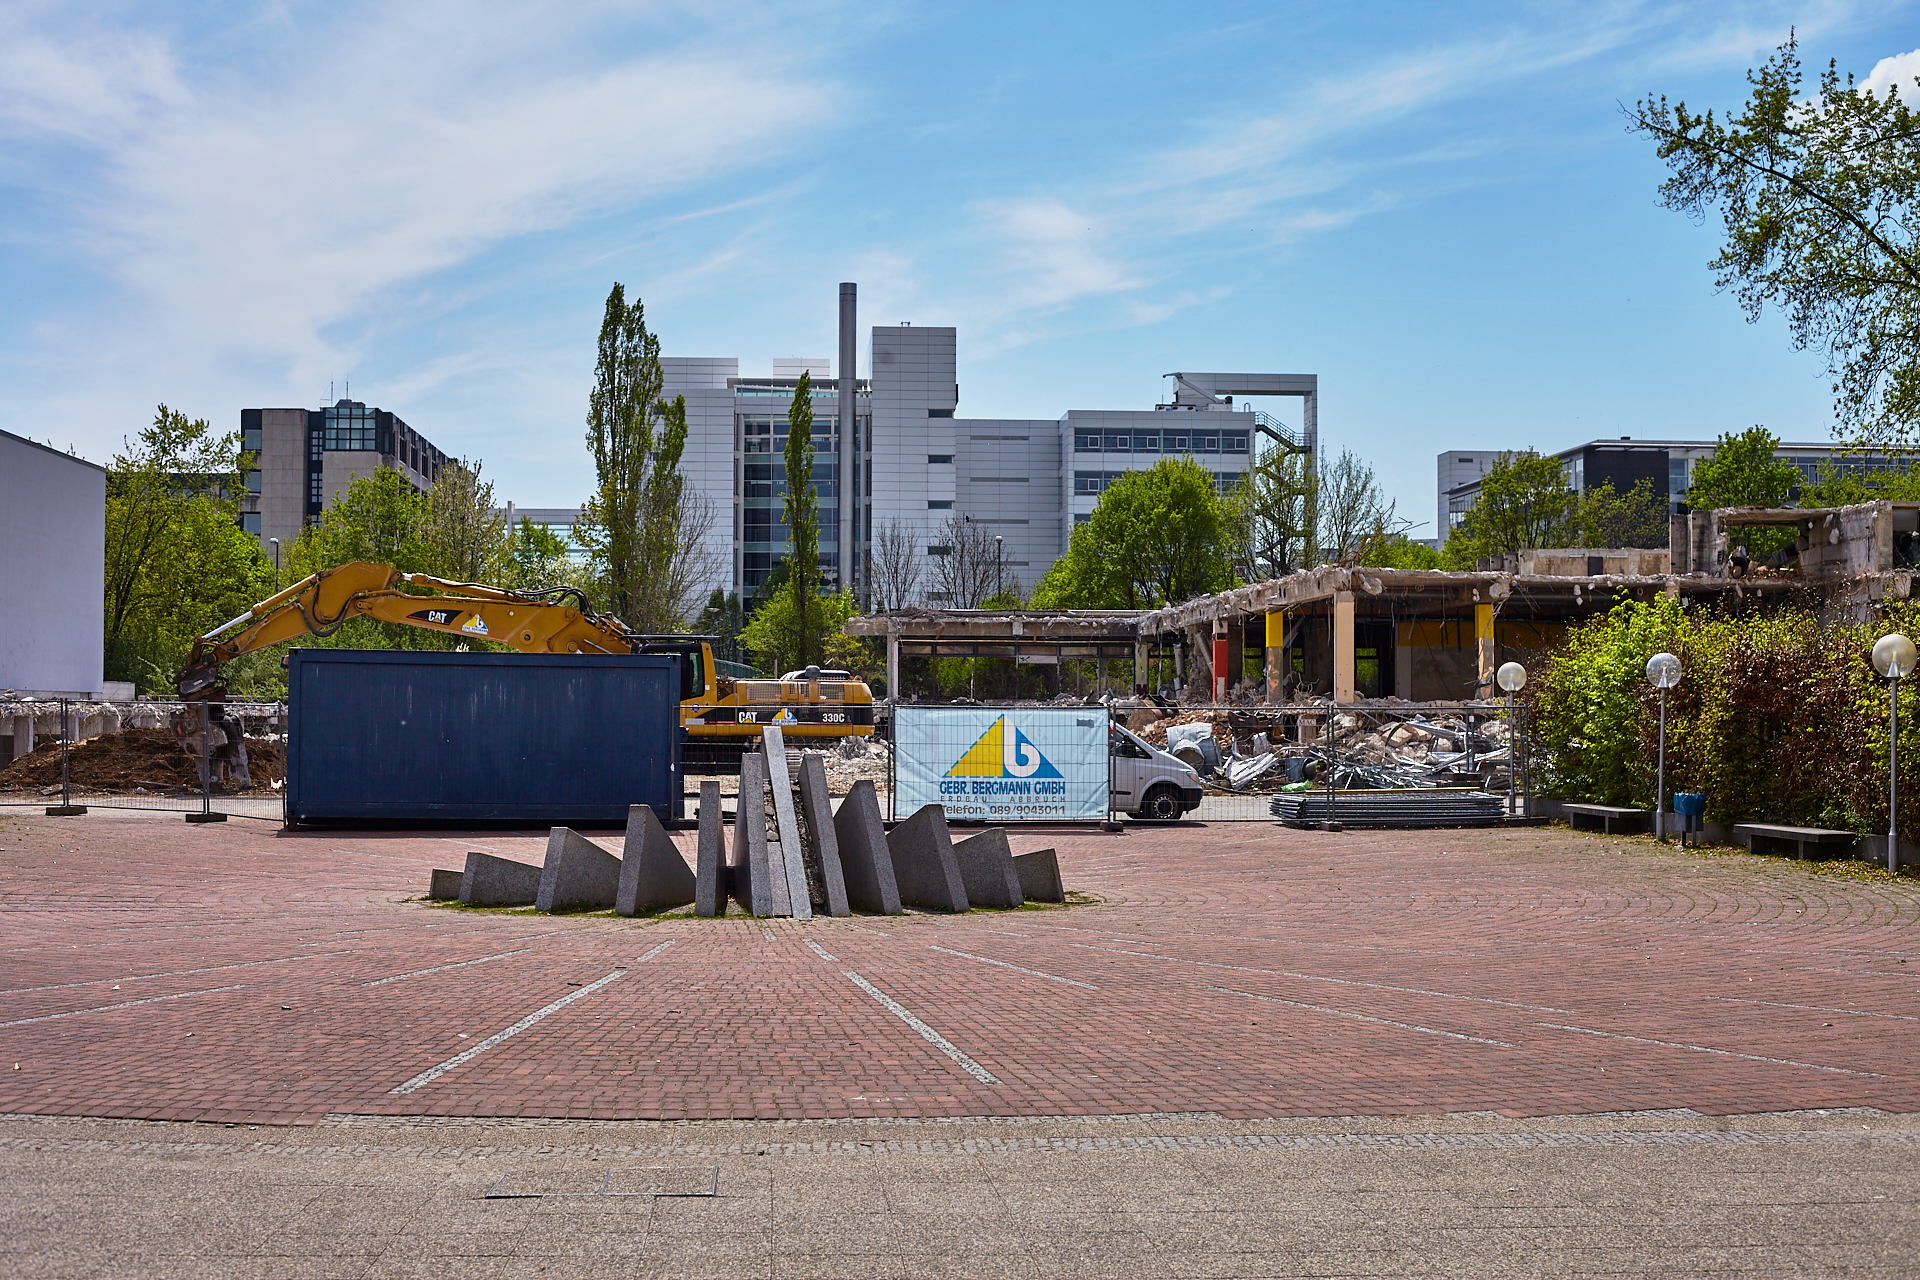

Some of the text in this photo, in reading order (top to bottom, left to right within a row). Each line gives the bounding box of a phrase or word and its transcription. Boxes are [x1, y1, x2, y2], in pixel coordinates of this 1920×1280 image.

[428, 610, 448, 624] CAT
[738, 711, 758, 724] CAT
[822, 712, 845, 723] 330C
[940, 781, 1066, 795] GEBR. BERGMANN GMBH
[940, 795, 1066, 803] ERDBAU ABBRUCH
[989, 804, 1066, 816] 089/9043011
